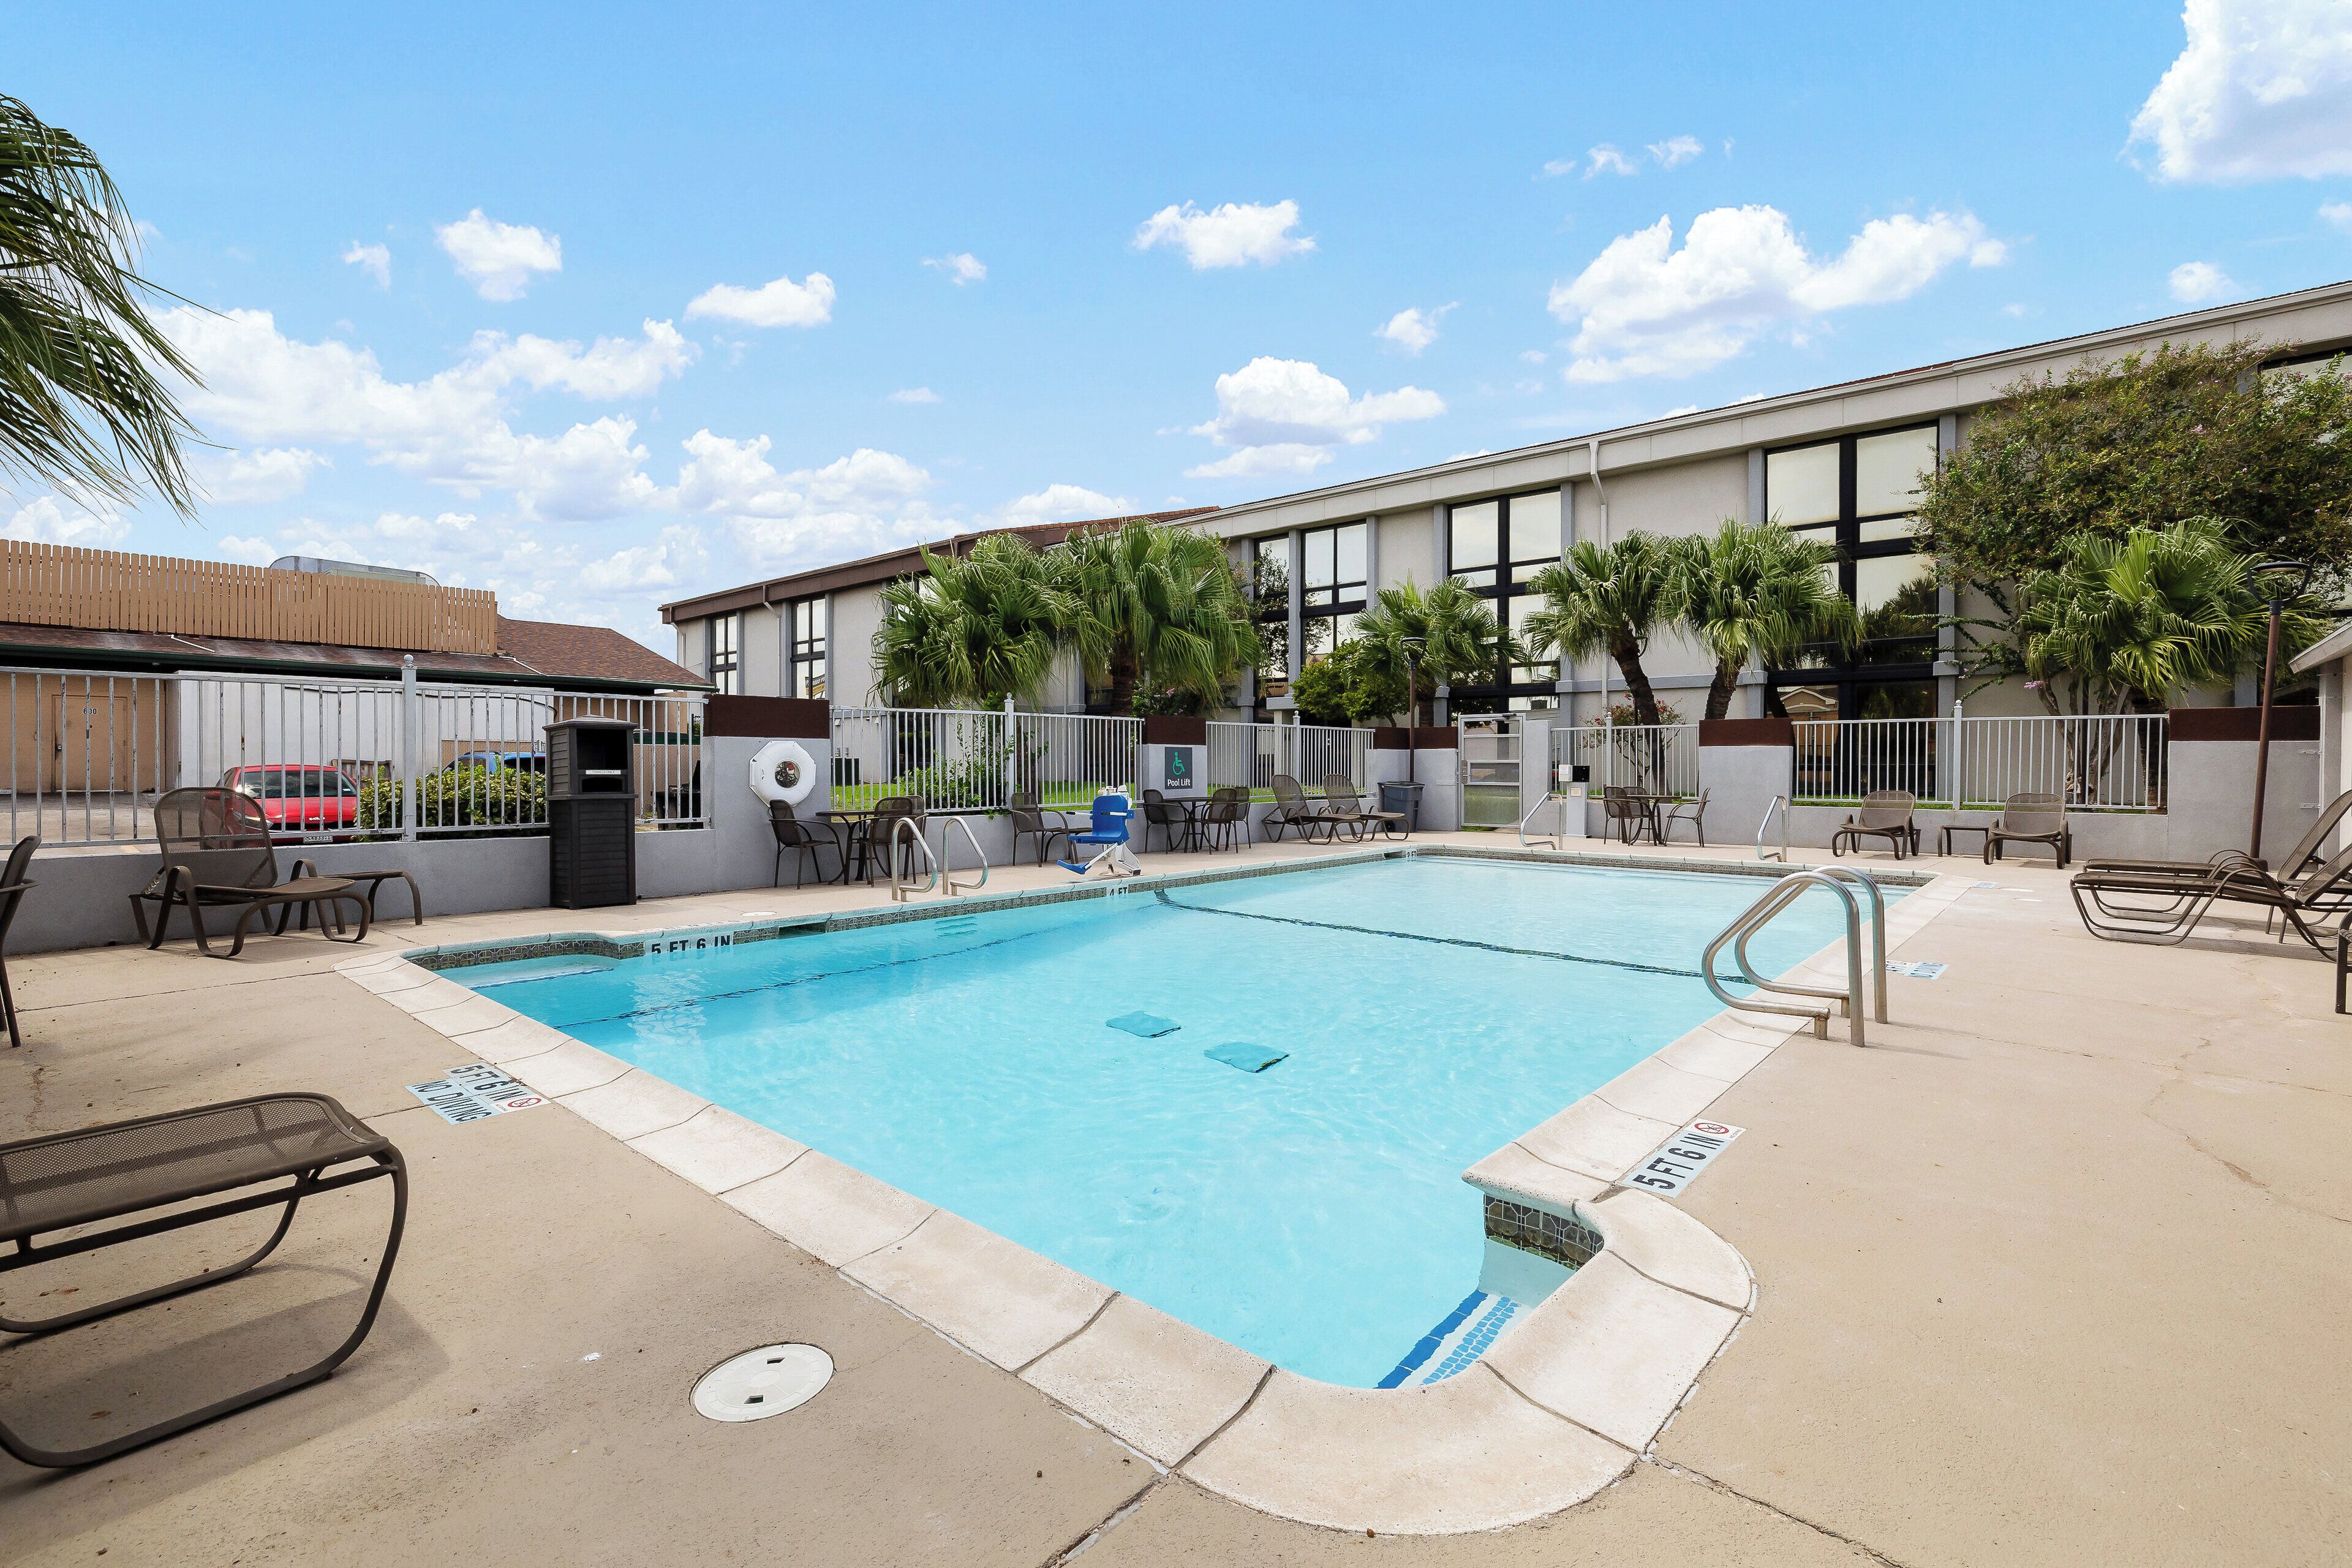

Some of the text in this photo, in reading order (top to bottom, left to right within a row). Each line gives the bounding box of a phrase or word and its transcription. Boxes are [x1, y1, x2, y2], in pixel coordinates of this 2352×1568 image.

[651, 935, 731, 954] 5 FT 6 IN
[459, 1071, 500, 1083] FT
[473, 1080, 509, 1091] 6
[412, 1080, 492, 1122] NO DIVING
[485, 1088, 527, 1101] IN
[1679, 1133, 1725, 1150] IN
[1668, 1147, 1707, 1160] 6
[1646, 1157, 1694, 1178] FT
[1632, 1174, 1676, 1189] 5
